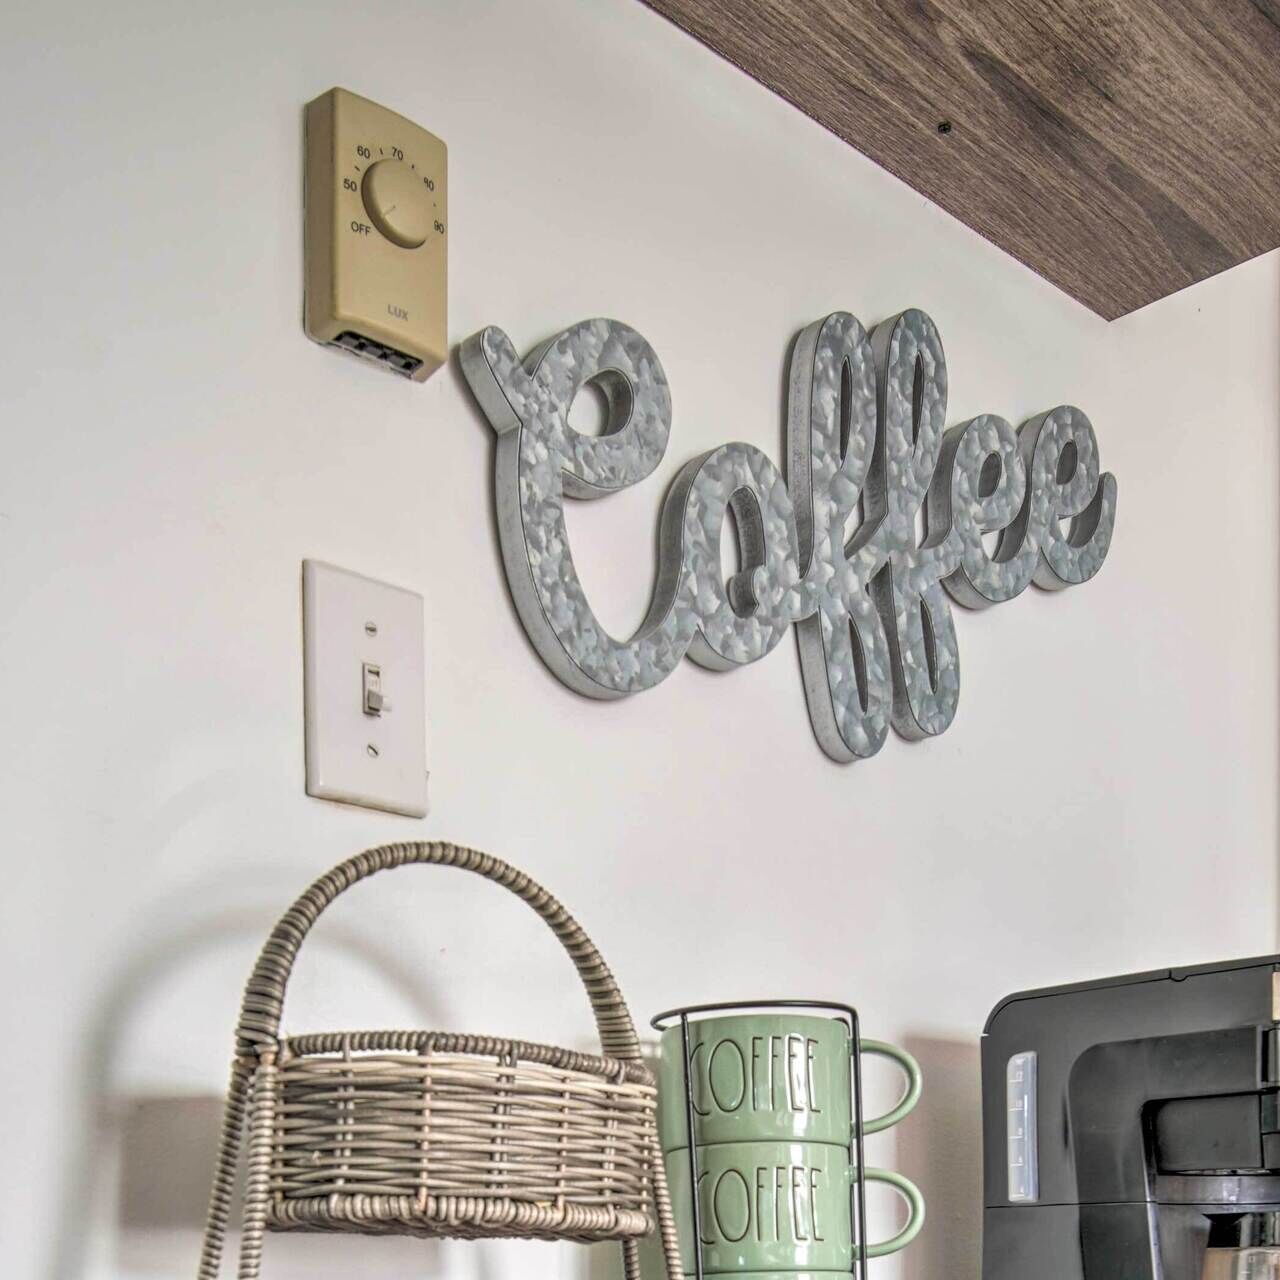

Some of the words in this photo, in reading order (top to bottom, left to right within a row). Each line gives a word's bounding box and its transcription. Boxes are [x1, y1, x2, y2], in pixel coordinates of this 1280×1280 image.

[357, 145, 371, 160] 60
[391, 146, 405, 161] 70
[343, 178, 357, 192] 50
[350, 220, 372, 236] OFF
[387, 303, 410, 322] LUX
[460, 308, 1118, 764] Coffee
[688, 1035, 821, 1117] COFFEE
